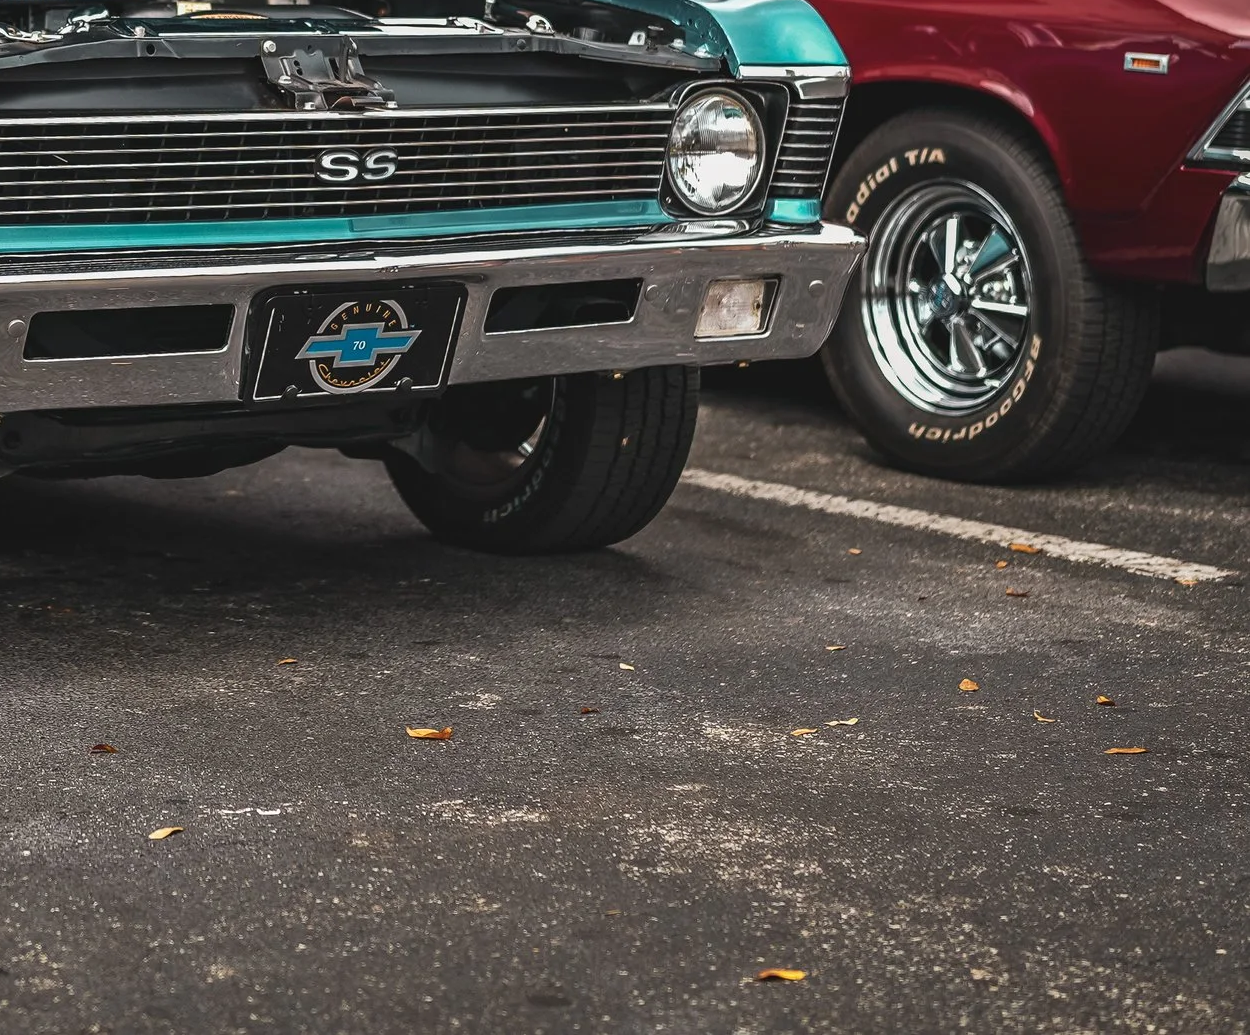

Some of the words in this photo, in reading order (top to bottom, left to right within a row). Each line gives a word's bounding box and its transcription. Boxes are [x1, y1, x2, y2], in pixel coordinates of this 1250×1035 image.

[315, 148, 398, 182] SS
[844, 156, 901, 223] adial
[904, 146, 947, 165] T/A
[330, 303, 397, 330] GENUINE
[352, 340, 366, 351] 70
[318, 358, 391, 388] Chevrolet
[908, 333, 1043, 444] BFGoodrich
